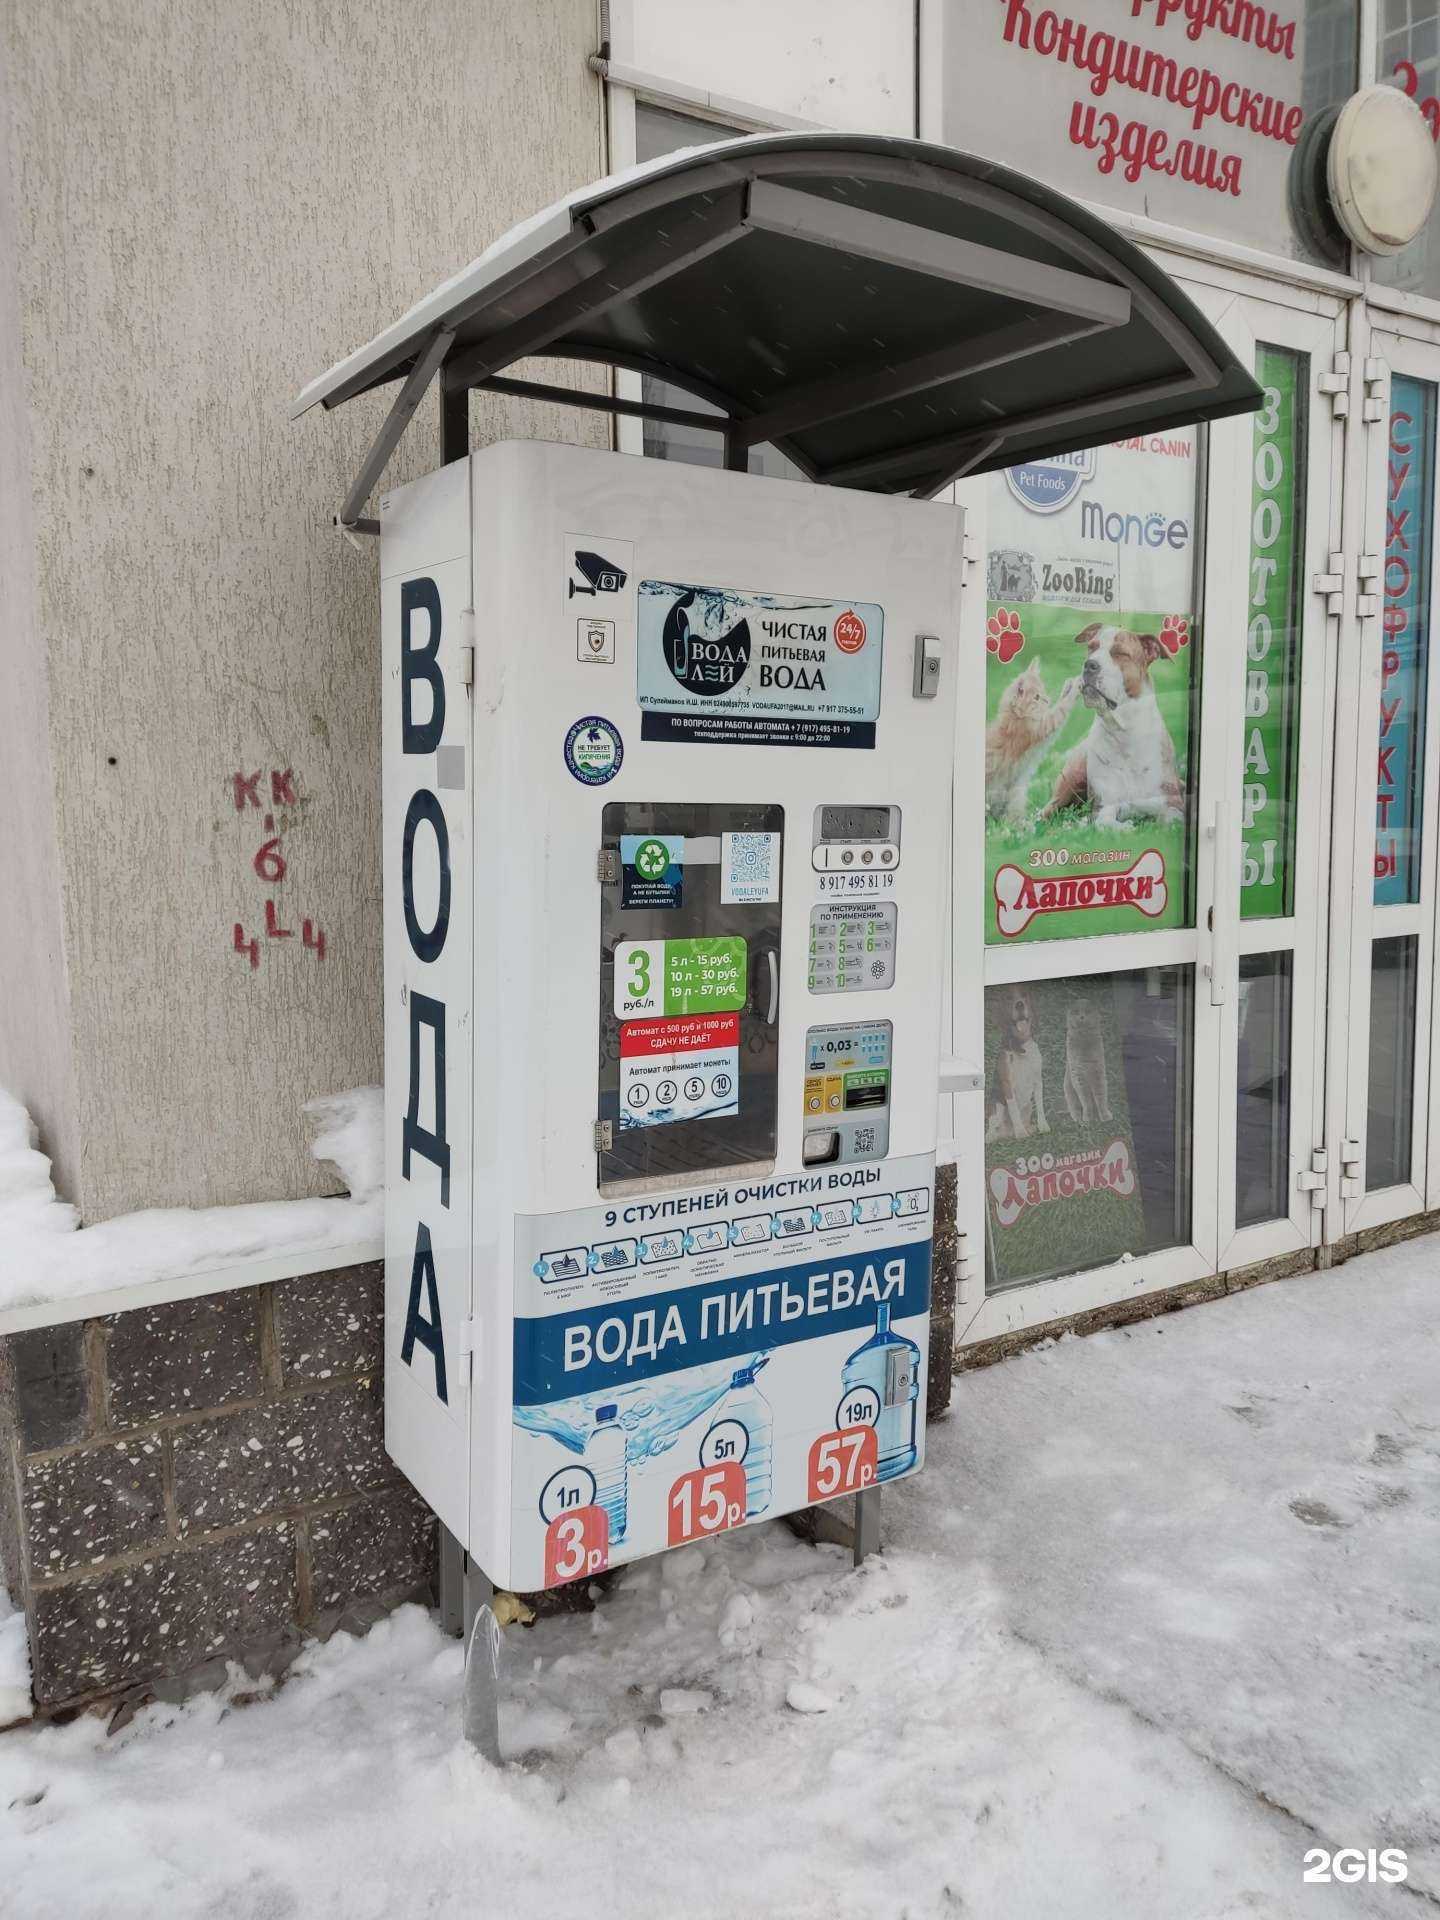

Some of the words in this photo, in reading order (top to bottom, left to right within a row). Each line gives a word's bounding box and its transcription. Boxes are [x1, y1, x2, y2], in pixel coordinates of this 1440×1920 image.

[1003, 0, 1303, 146] Кондитерские
[1068, 101, 1242, 197] изделия
[1150, 437, 1191, 459] CANIN
[1019, 471, 1035, 486] Pet
[1037, 474, 1066, 491] Foods
[1042, 563, 1114, 604] ZooRing
[761, 621, 827, 642] ЧИСТАЯ
[840, 622, 861, 640] 24/7
[1241, 386, 1283, 888] ЗООТОВАРЫ
[691, 642, 748, 664] ВОДА
[761, 645, 826, 663] ПИТЬЕВАЯ
[1373, 411, 1414, 879] СУХОФРУКТЫ
[759, 664, 827, 691] ВОДА
[671, 718, 682, 727] ПО
[683, 718, 723, 729] ВОПРОСАМ
[724, 720, 753, 730] РАБОТЫ
[754, 722, 790, 731] АВТОМАТА
[801, 724, 819, 734] (917)
[819, 725, 851, 734] 495-81-19
[820, 876, 826, 890] 8
[828, 876, 846, 890] 917
[848, 875, 865, 889] 495
[868, 874, 879, 888] 81
[883, 873, 894, 888] 19
[1013, 874, 1154, 910] Лапочки
[829, 904, 877, 913] ИНСТРУКЦИЯ
[832, 911, 884, 920] ПРИМЕНЕНИЮ
[840, 922, 847, 936] 2
[867, 938, 874, 952] 6
[671, 957, 678, 966] 5
[680, 957, 687, 966] л
[696, 955, 708, 965] 15
[710, 953, 733, 966] руб.
[627, 949, 651, 998] 3
[671, 972, 682, 982] 10
[684, 972, 692, 981] л
[701, 970, 715, 980] 30
[717, 967, 739, 981] руб.
[401, 575, 451, 1407] ВОДА
[671, 987, 682, 997] 19
[683, 987, 692, 996] л
[701, 984, 713, 995] 57
[716, 983, 738, 997] руб.
[623, 998, 654, 1011] руб./л
[626, 1027, 659, 1037] Автомат
[666, 1024, 680, 1033] 500
[681, 1022, 695, 1034] руб
[702, 1020, 719, 1030] 1000
[720, 1019, 734, 1030] руб
[651, 1037, 678, 1049] СДАЧУ
[679, 1036, 689, 1045] НЕ
[826, 1040, 851, 1053] 0,03
[629, 1066, 661, 1077] Автомат
[662, 1062, 702, 1074] принимает
[703, 1059, 731, 1068] монеты
[634, 1088, 640, 1100] 1
[663, 1084, 670, 1097] 2
[691, 1080, 698, 1093] 5
[716, 1077, 727, 1090] 10
[1002, 1157, 1126, 1209] Лапочки
[604, 1210, 617, 1228] 9
[623, 1188, 729, 1224] СТУПЕНЕЙ
[734, 1174, 823, 1205] ОЧИСТКИ
[828, 1167, 882, 1189] ВОДЫ
[563, 1304, 688, 1372] ВОДА
[700, 1258, 907, 1340] ПИТЬЕВАЯ
[845, 1402, 873, 1423] 19л
[714, 1438, 735, 1460] 5л
[556, 1486, 580, 1508] 1л
